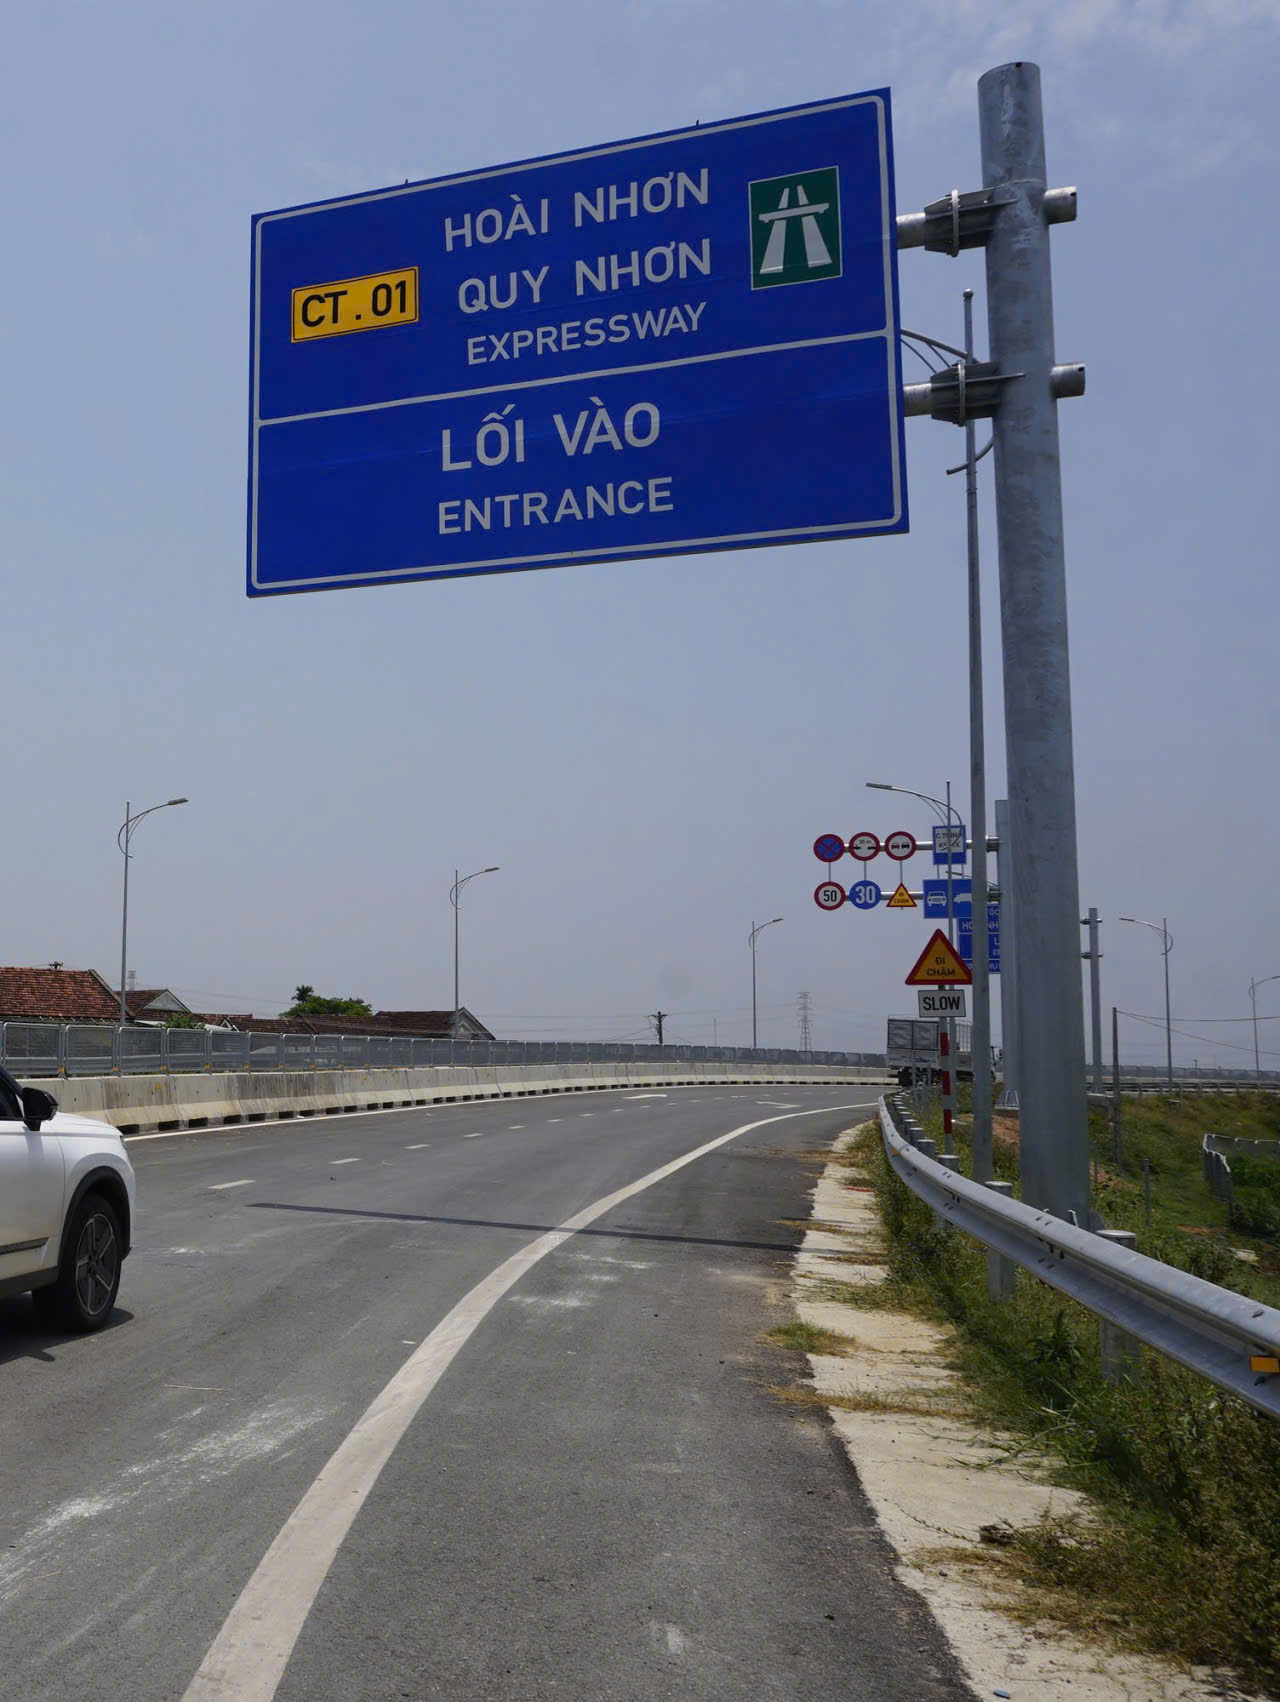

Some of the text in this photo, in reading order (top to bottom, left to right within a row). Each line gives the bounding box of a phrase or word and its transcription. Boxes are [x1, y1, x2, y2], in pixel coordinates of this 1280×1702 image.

[444, 168, 709, 252] HOÀI NHƠN
[458, 238, 711, 314] QUY NHƠN
[467, 301, 707, 366] EXPRESSWAY
[442, 396, 661, 472] LỐI VÀO
[438, 476, 674, 535] ENTRANCE
[823, 889, 837, 902] 50
[855, 885, 876, 904] 30
[922, 995, 960, 1011] SLOW
